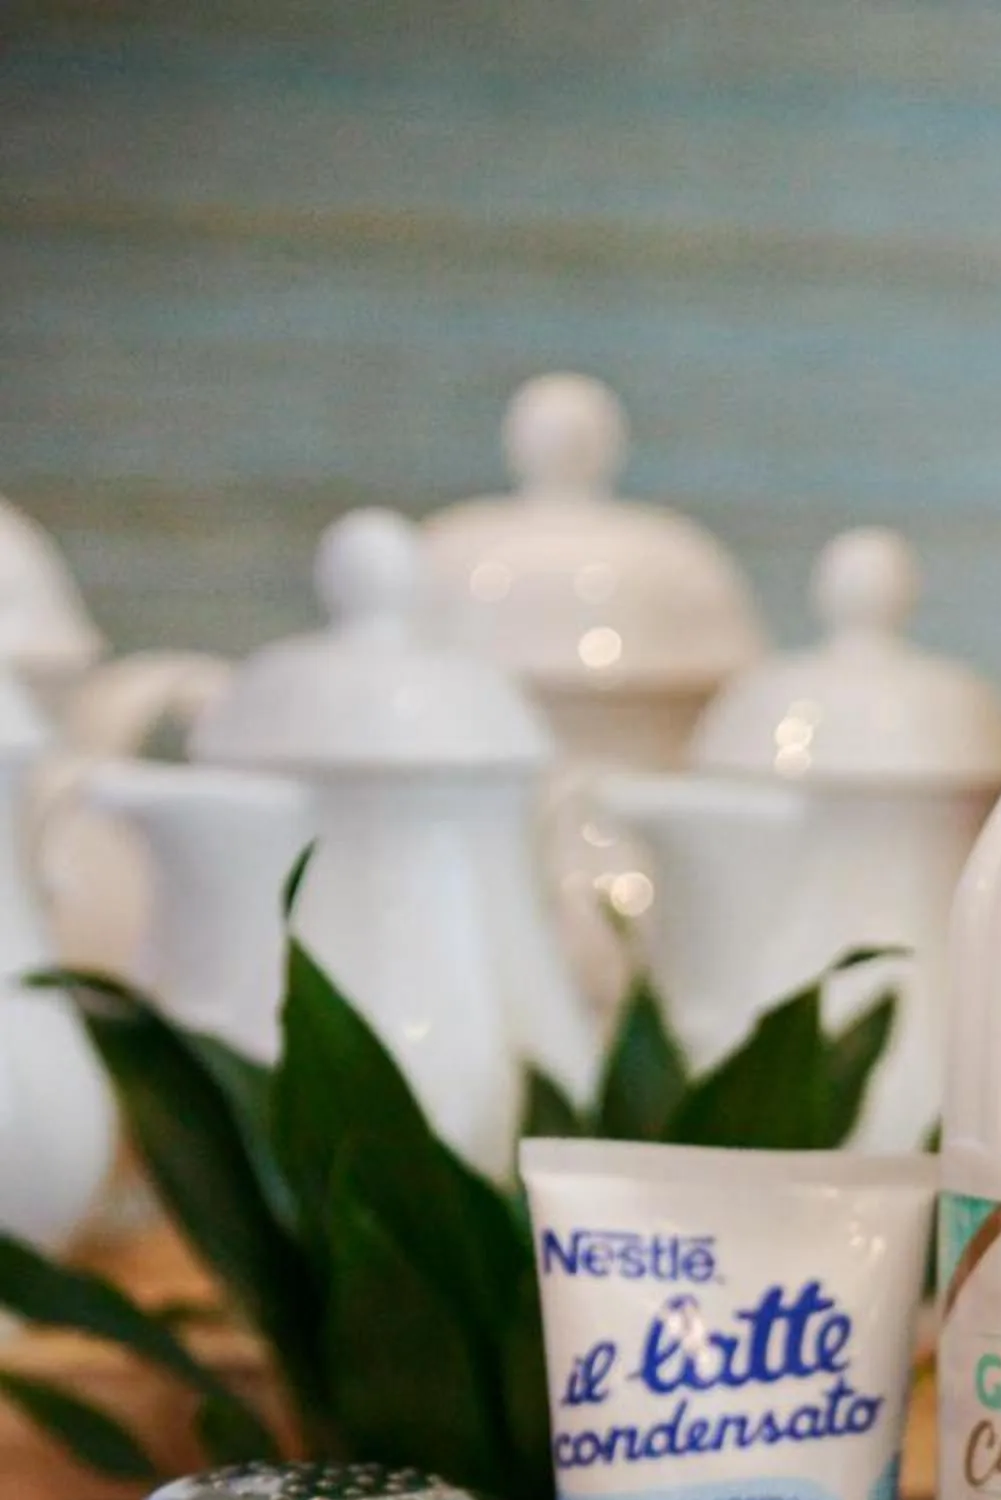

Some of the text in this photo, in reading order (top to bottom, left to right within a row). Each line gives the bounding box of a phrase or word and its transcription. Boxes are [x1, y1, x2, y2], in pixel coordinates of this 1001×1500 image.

[561, 1280, 852, 1406] il latte
[555, 1377, 884, 1469] condensato
